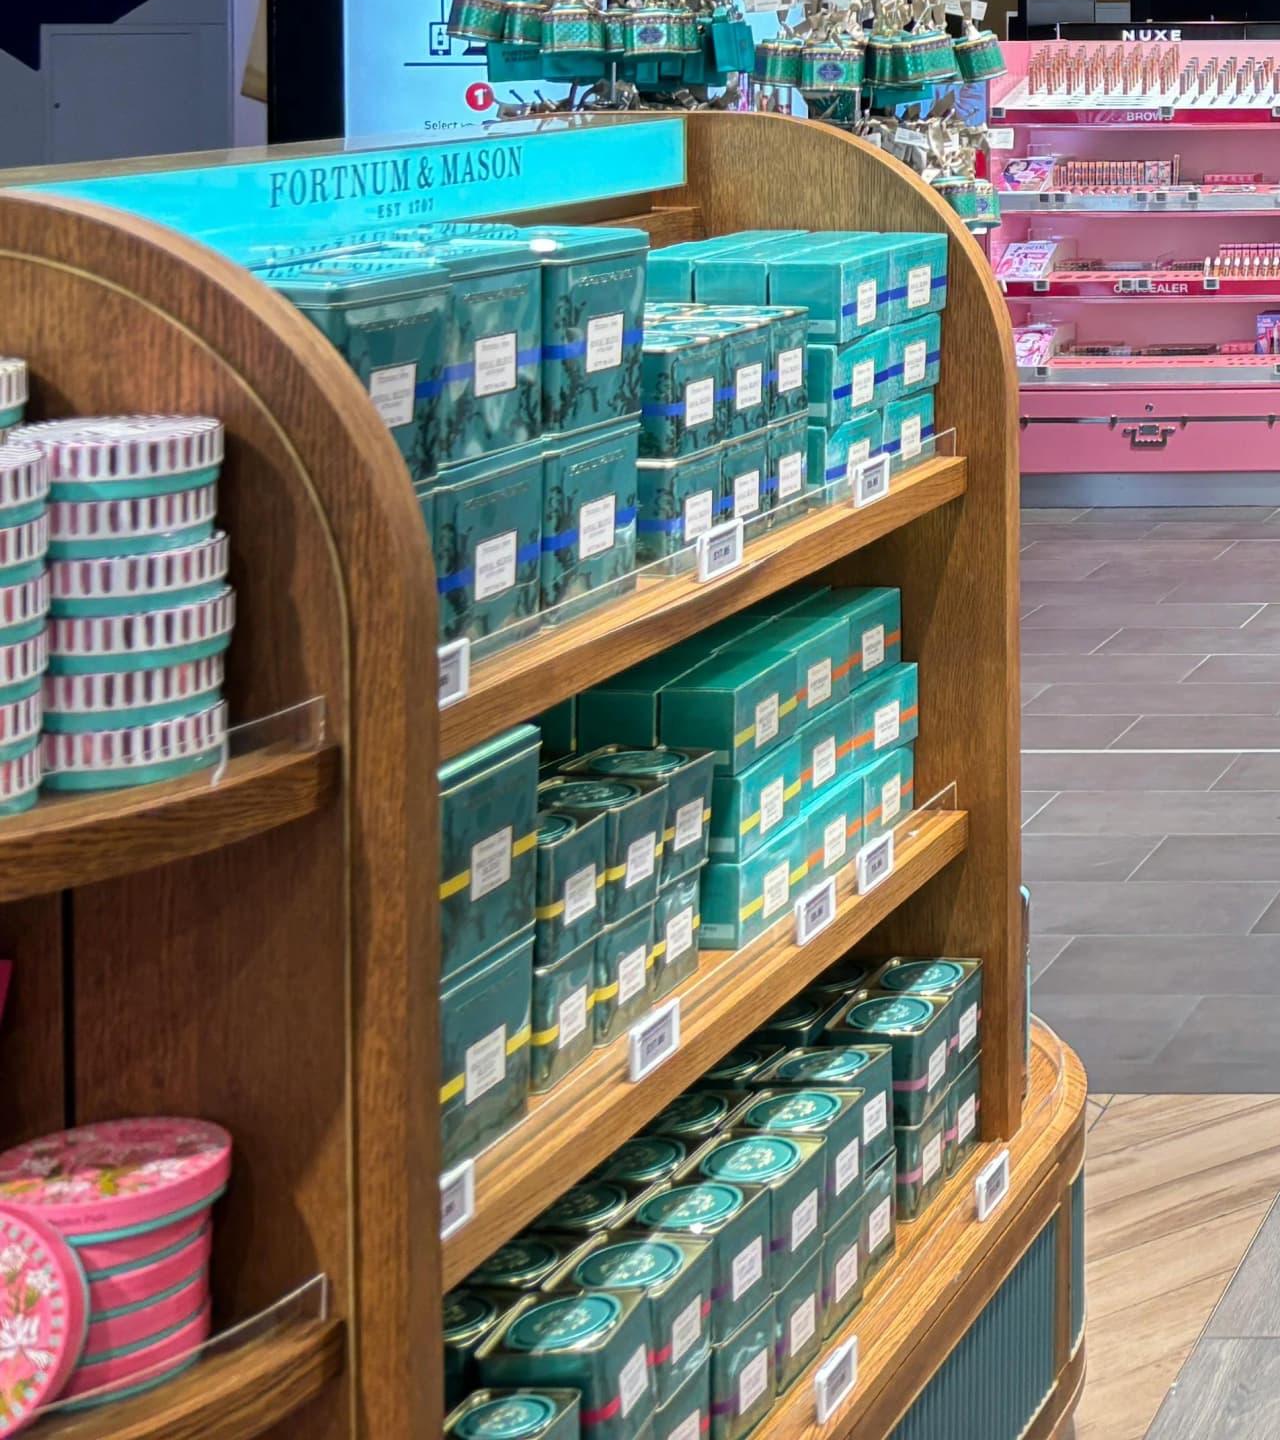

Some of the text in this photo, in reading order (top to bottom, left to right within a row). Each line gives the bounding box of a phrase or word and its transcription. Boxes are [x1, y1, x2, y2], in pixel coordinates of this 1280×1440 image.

[1122, 29, 1182, 41] NUXE
[269, 146, 523, 208] FORTNUM & MASON
